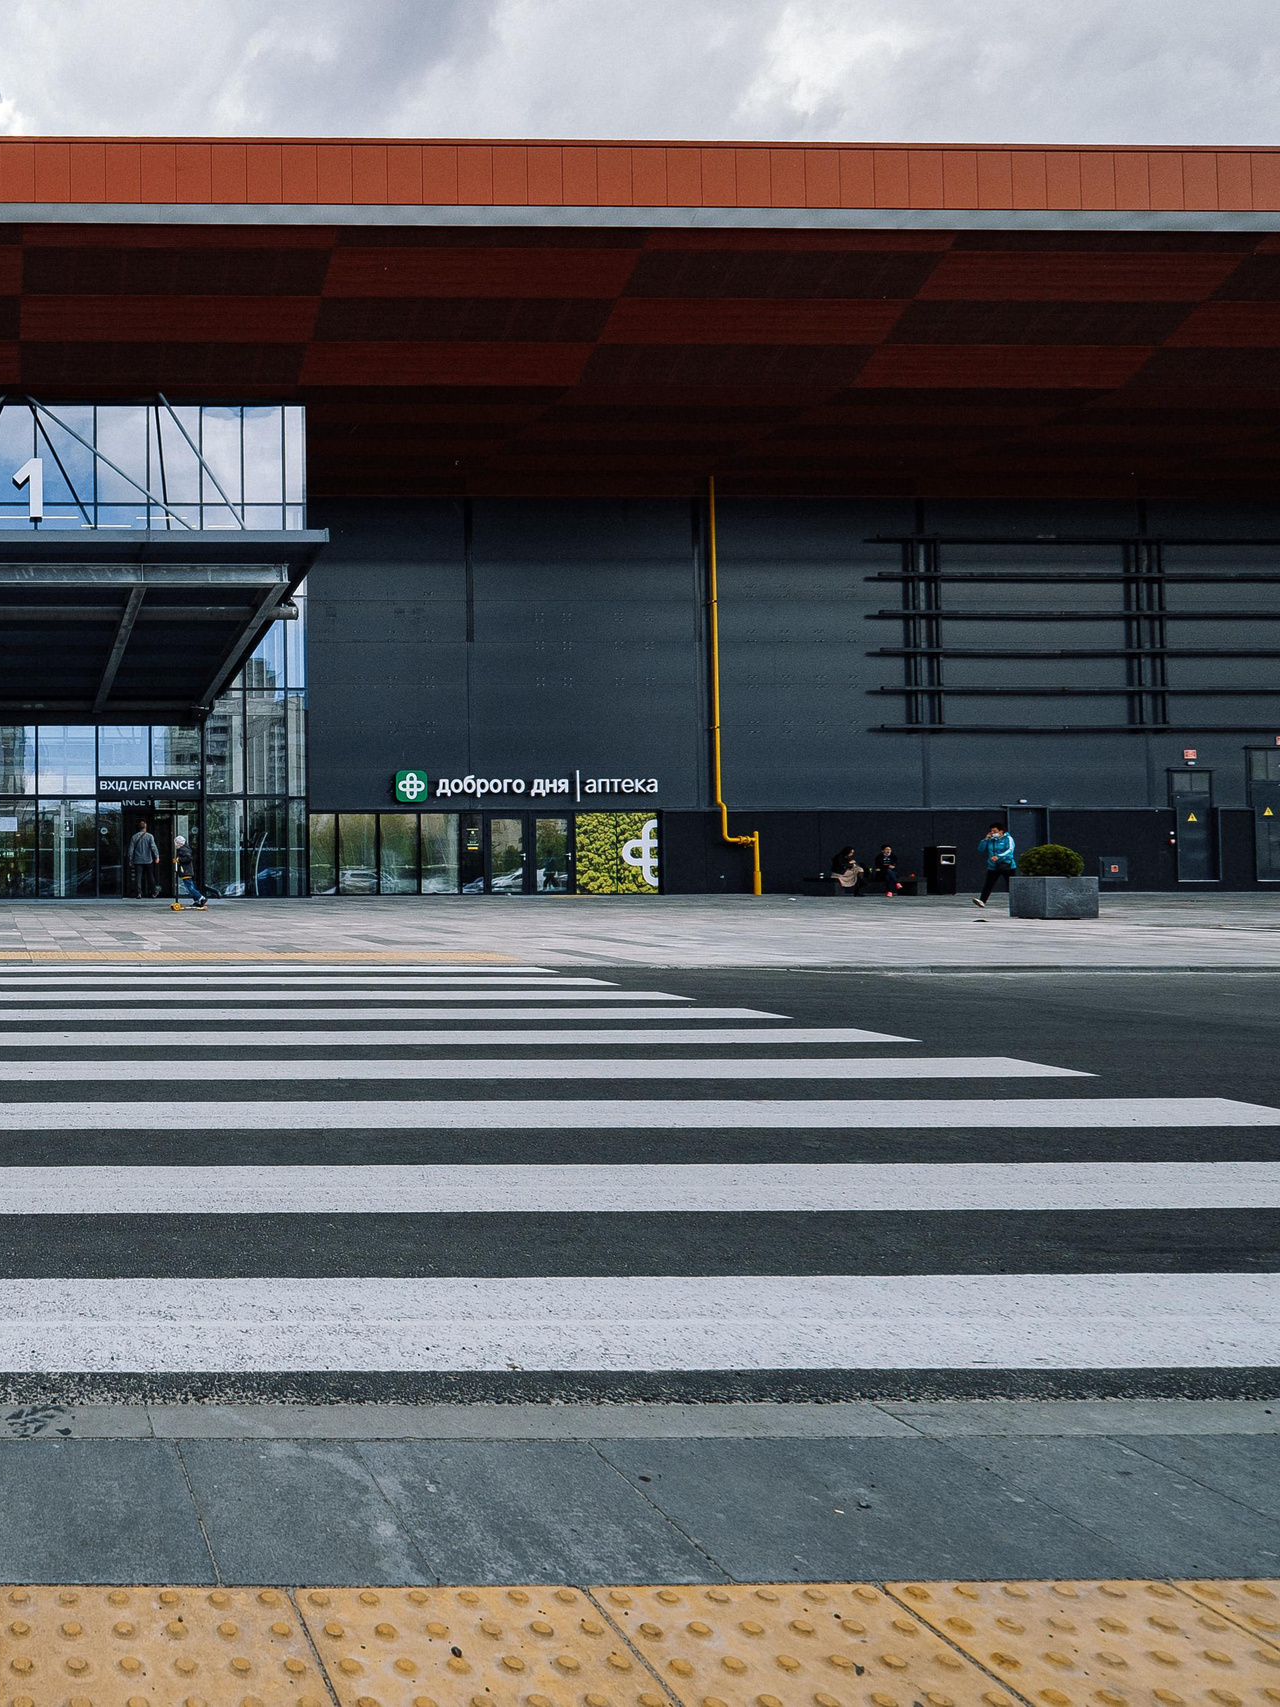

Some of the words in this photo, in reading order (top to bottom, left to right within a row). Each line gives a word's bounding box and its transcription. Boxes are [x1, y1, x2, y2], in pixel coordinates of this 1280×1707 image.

[13, 458, 42, 520] 1
[100, 780, 195, 791] ВХІД/ENTRANCE
[196, 780, 201, 790] 1
[436, 775, 525, 797] доброго
[530, 778, 569, 797] дня
[585, 778, 658, 793] аптека
